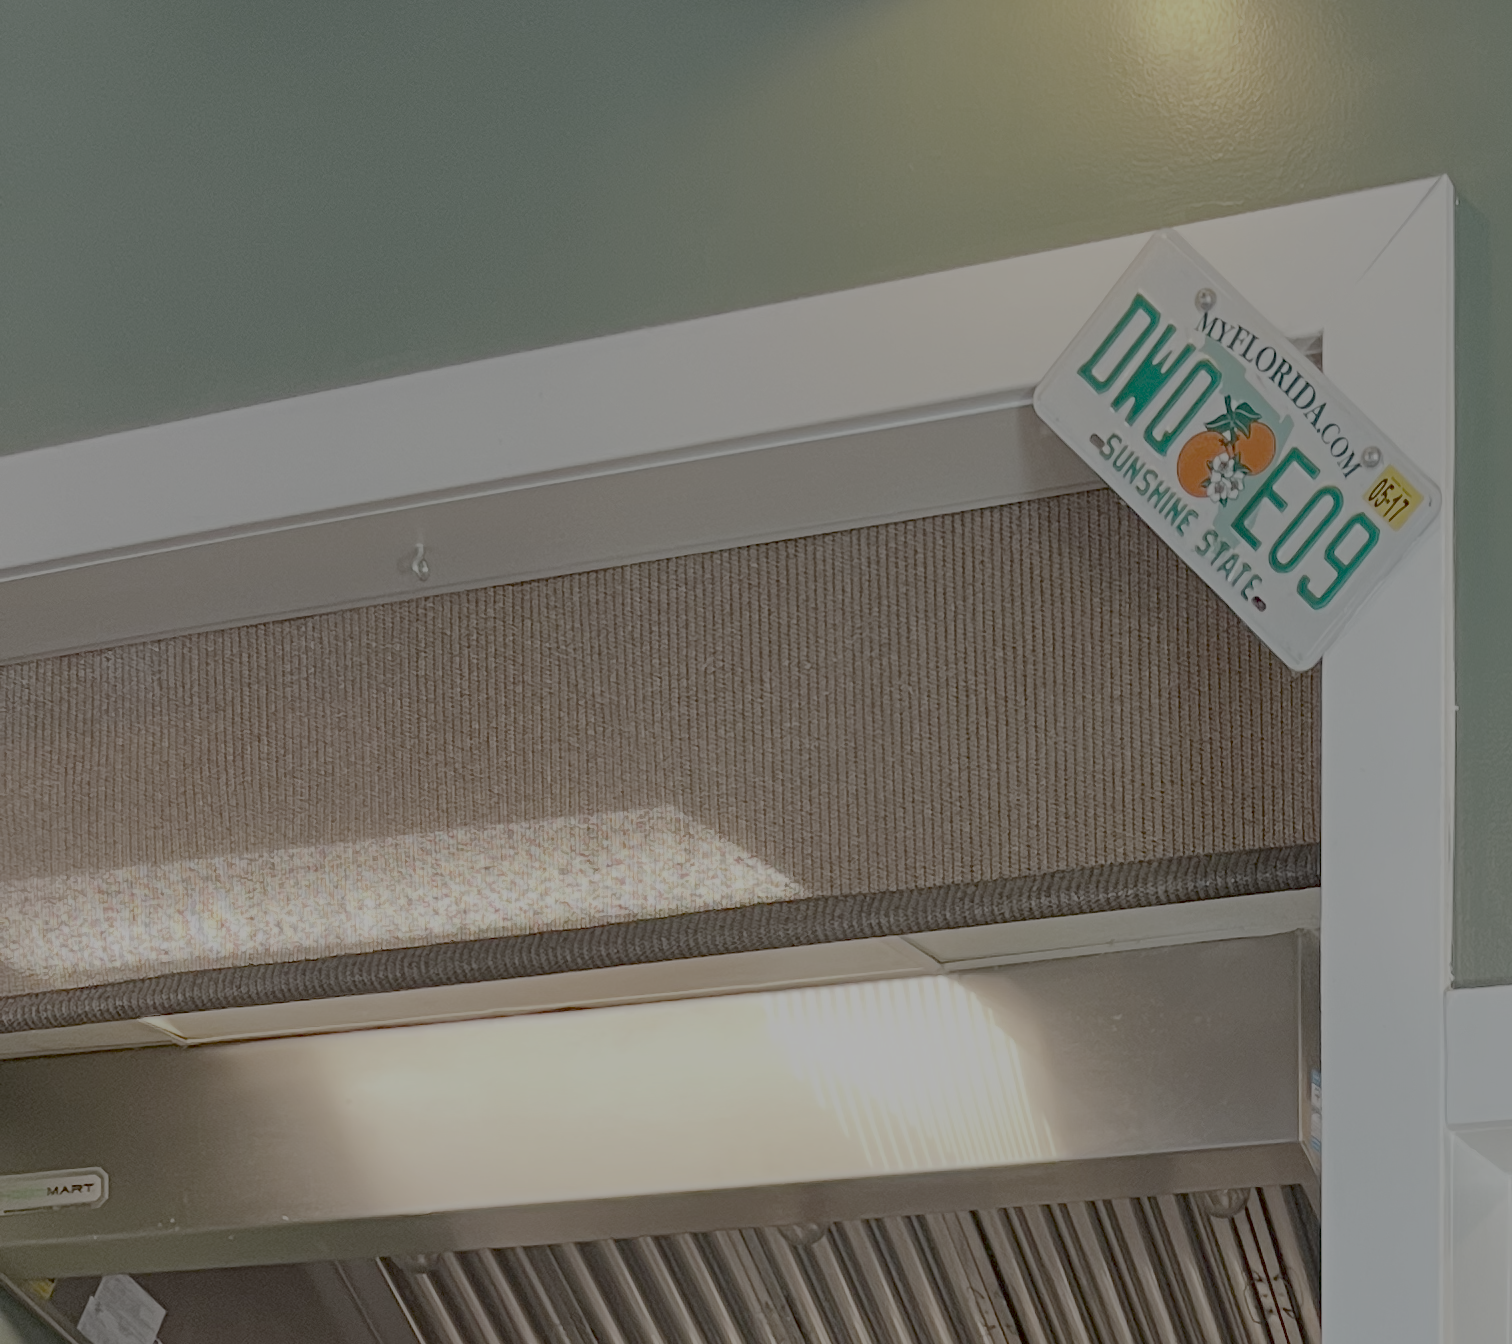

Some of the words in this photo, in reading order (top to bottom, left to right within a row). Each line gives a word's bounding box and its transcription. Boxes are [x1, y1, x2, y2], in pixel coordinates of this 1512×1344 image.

[1194, 310, 1362, 479] MYFLORIDA.COM
[1101, 432, 1199, 538] SUNSHINE
[1196, 528, 1264, 603] STATE
[1230, 446, 1381, 611] E09
[46, 1183, 95, 1196] MART
